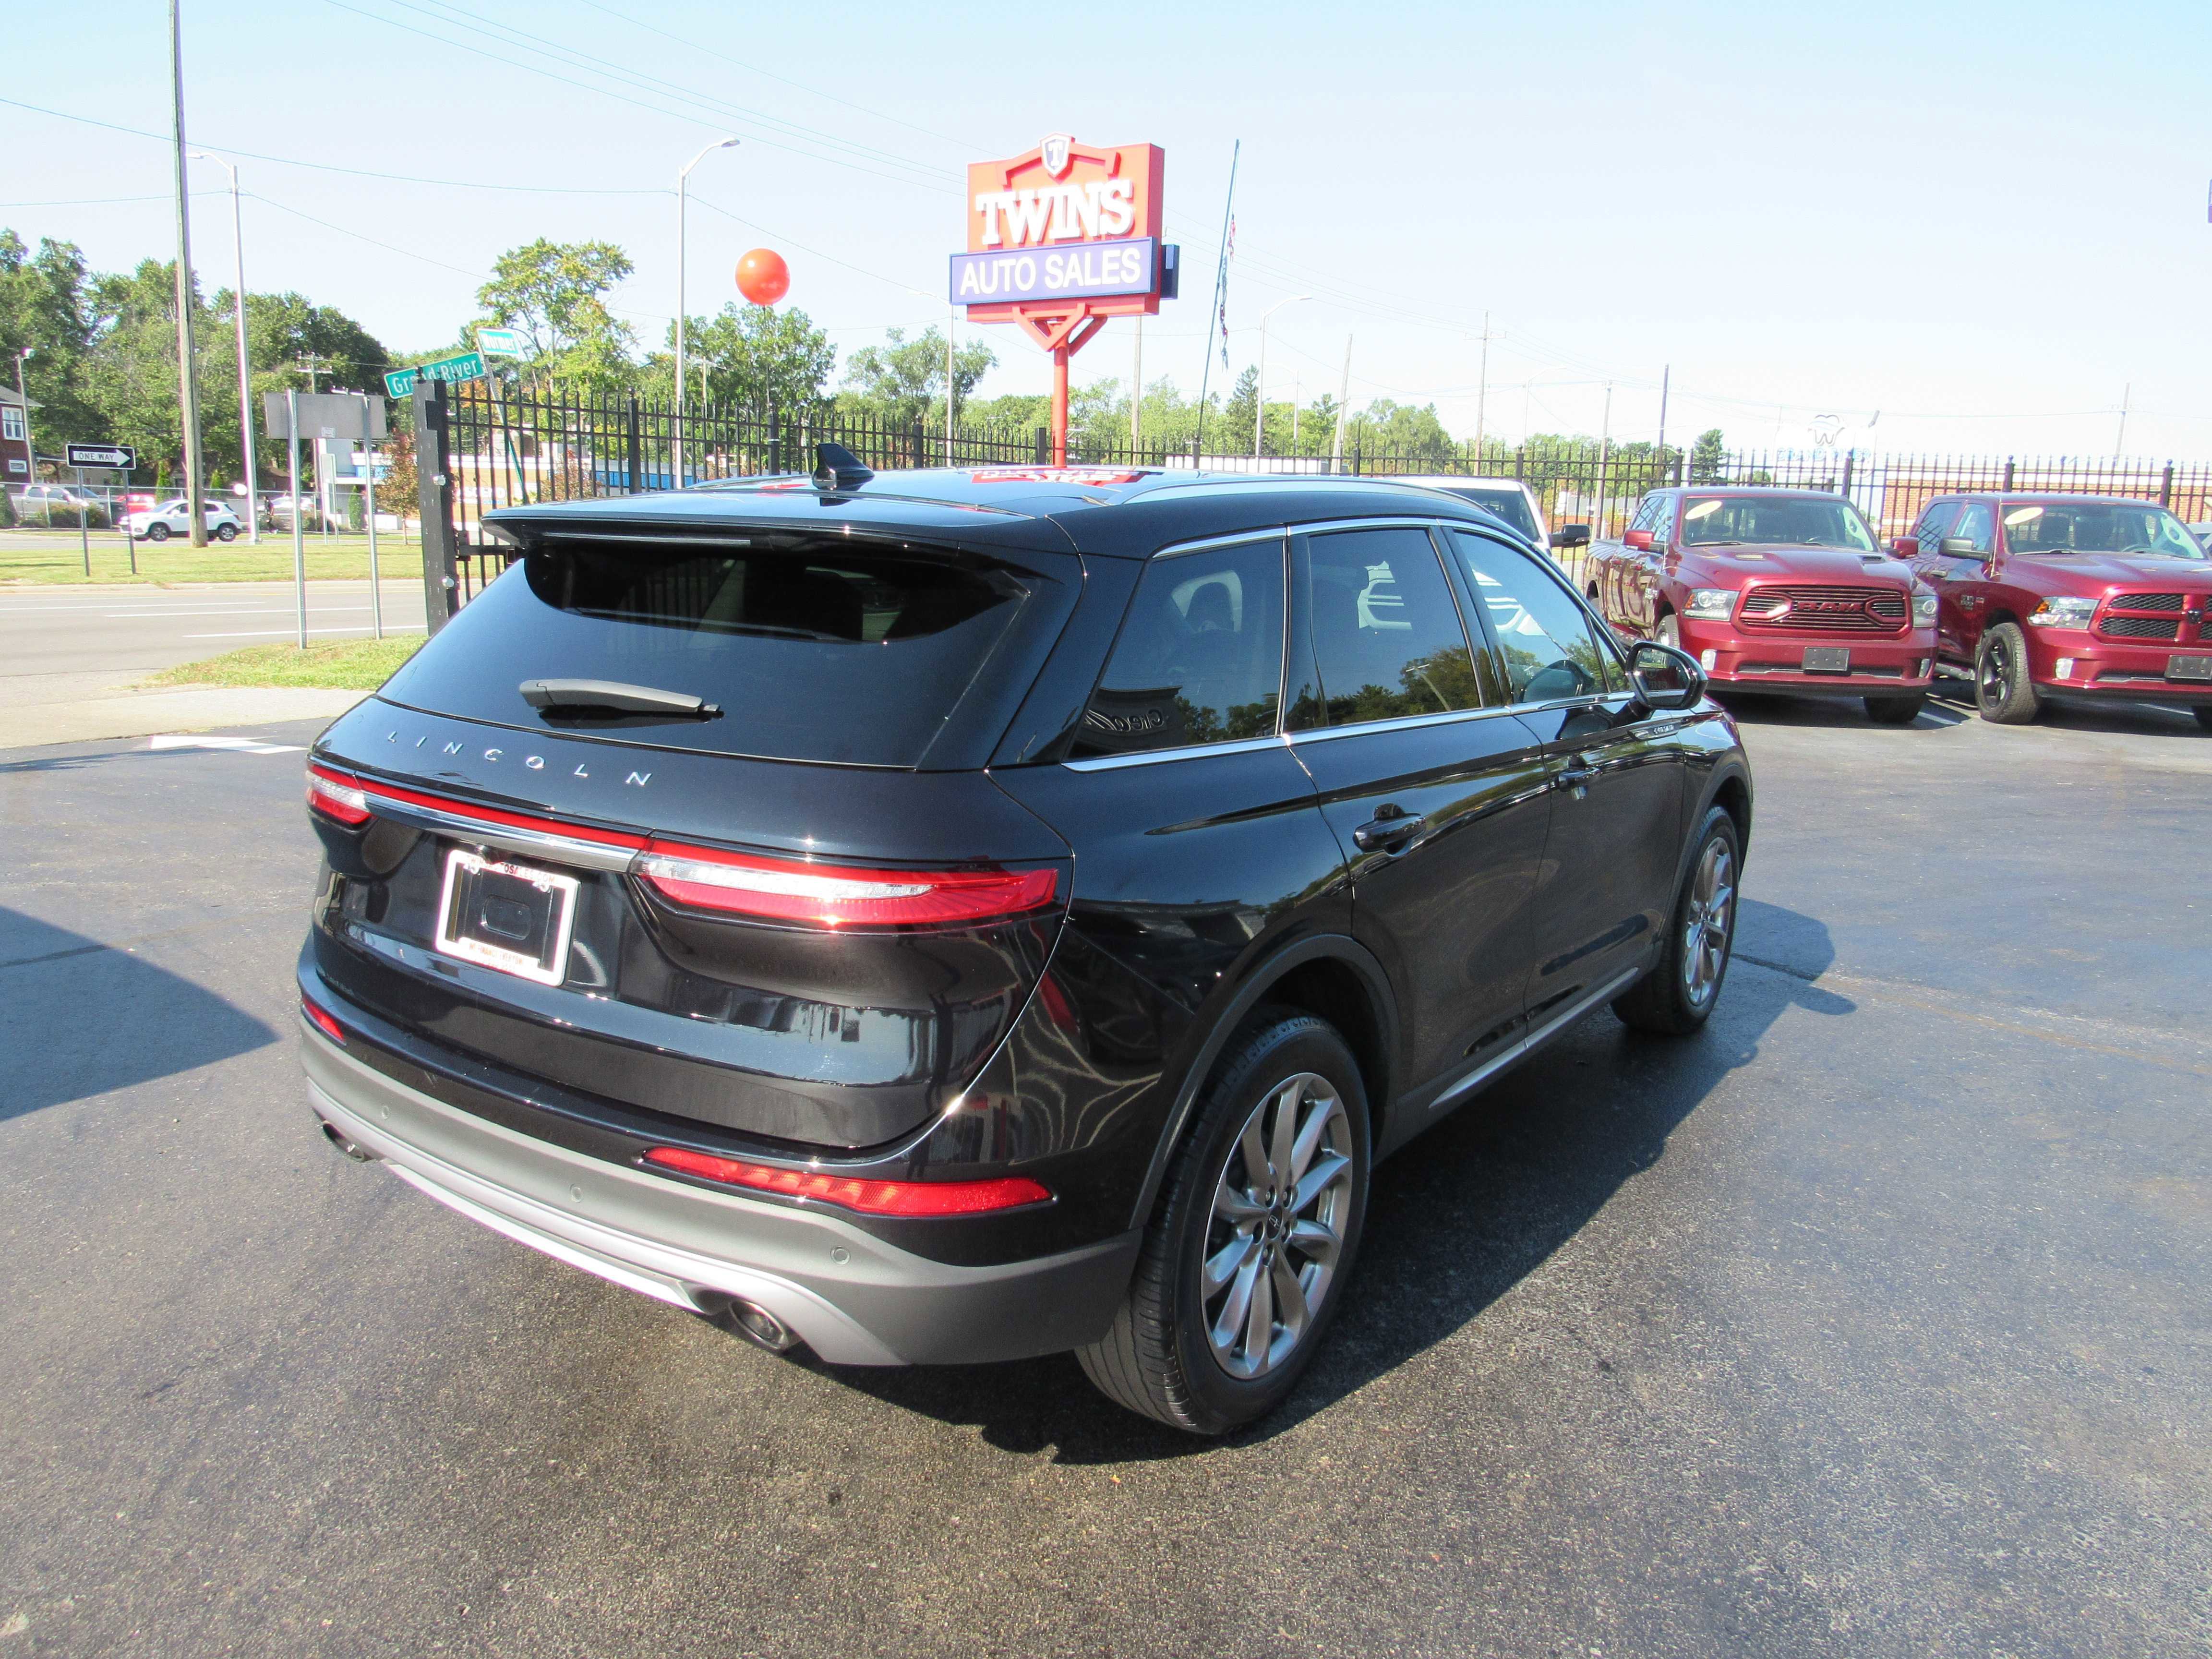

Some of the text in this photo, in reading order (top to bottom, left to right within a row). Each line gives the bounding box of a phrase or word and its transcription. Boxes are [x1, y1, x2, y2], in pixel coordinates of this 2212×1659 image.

[1046, 143, 1062, 167] T
[976, 179, 1134, 246] TWINS
[960, 248, 1141, 296] AUTO SALES
[439, 360, 478, 383] River
[1797, 601, 1861, 612] RAM
[387, 730, 653, 786] LINCOLN
